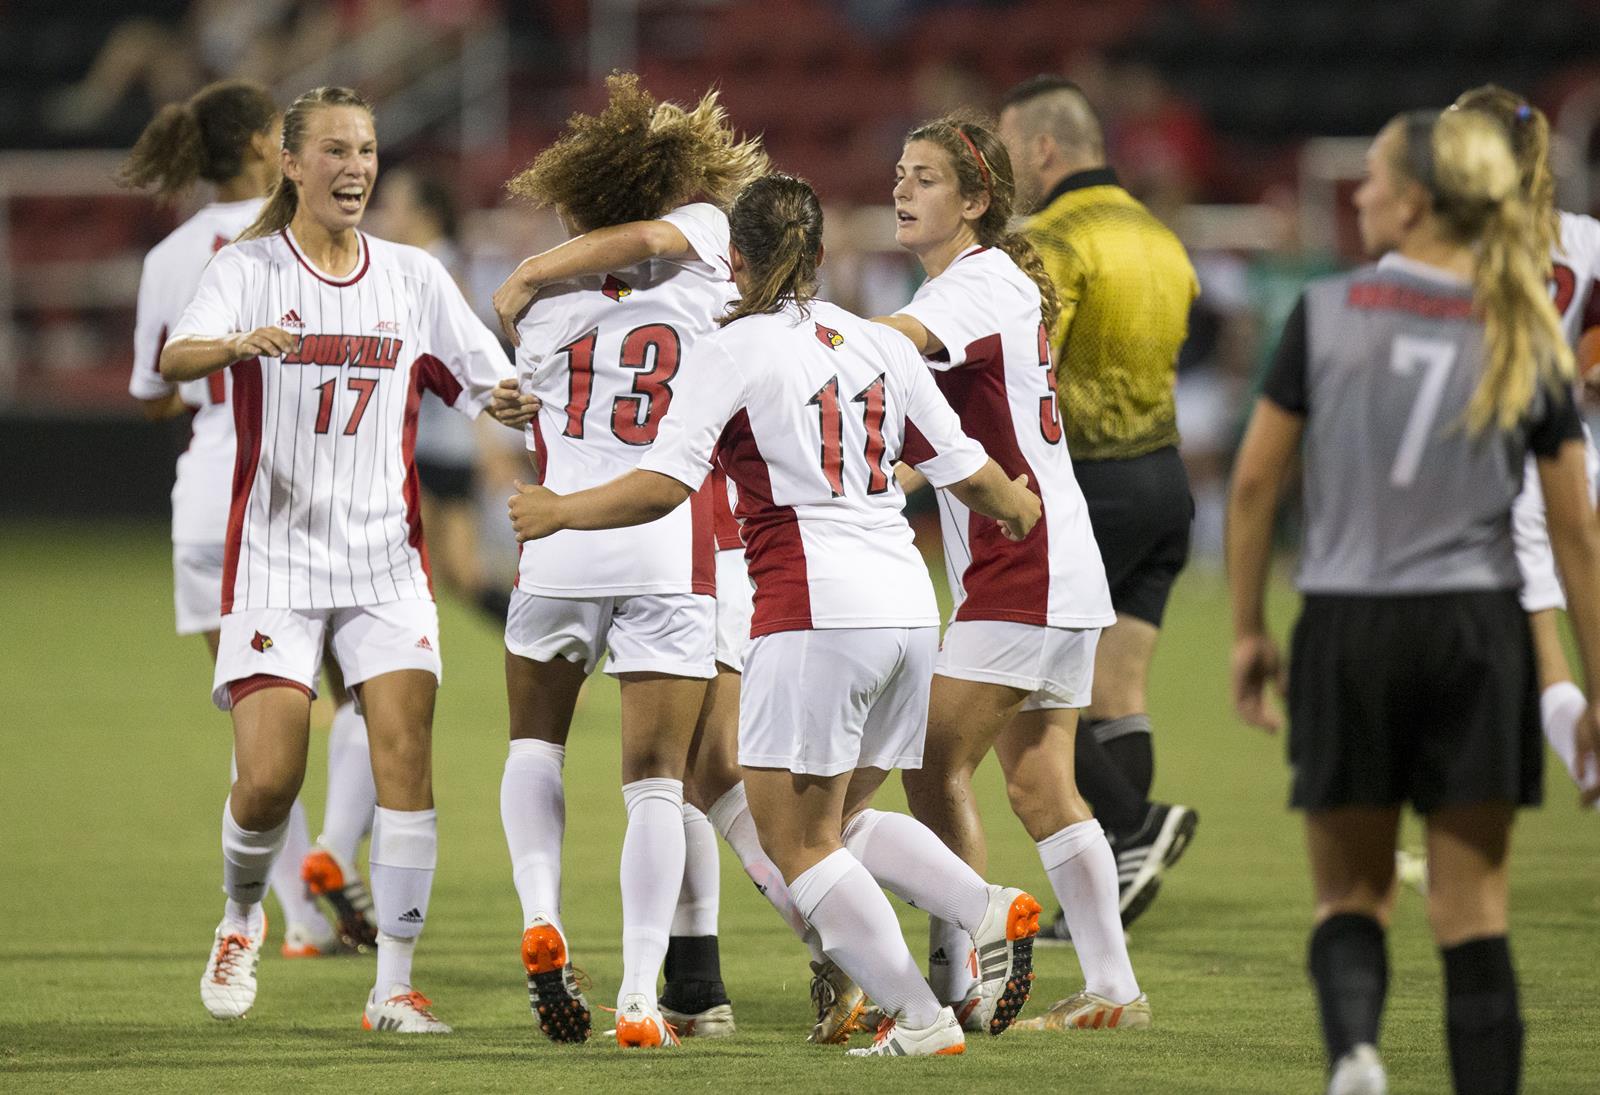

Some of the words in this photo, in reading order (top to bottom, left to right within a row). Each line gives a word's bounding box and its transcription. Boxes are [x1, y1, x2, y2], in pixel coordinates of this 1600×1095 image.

[312, 376, 380, 436] 17
[554, 322, 681, 446] 13
[804, 371, 888, 498] 11
[1391, 334, 1456, 484] 7
